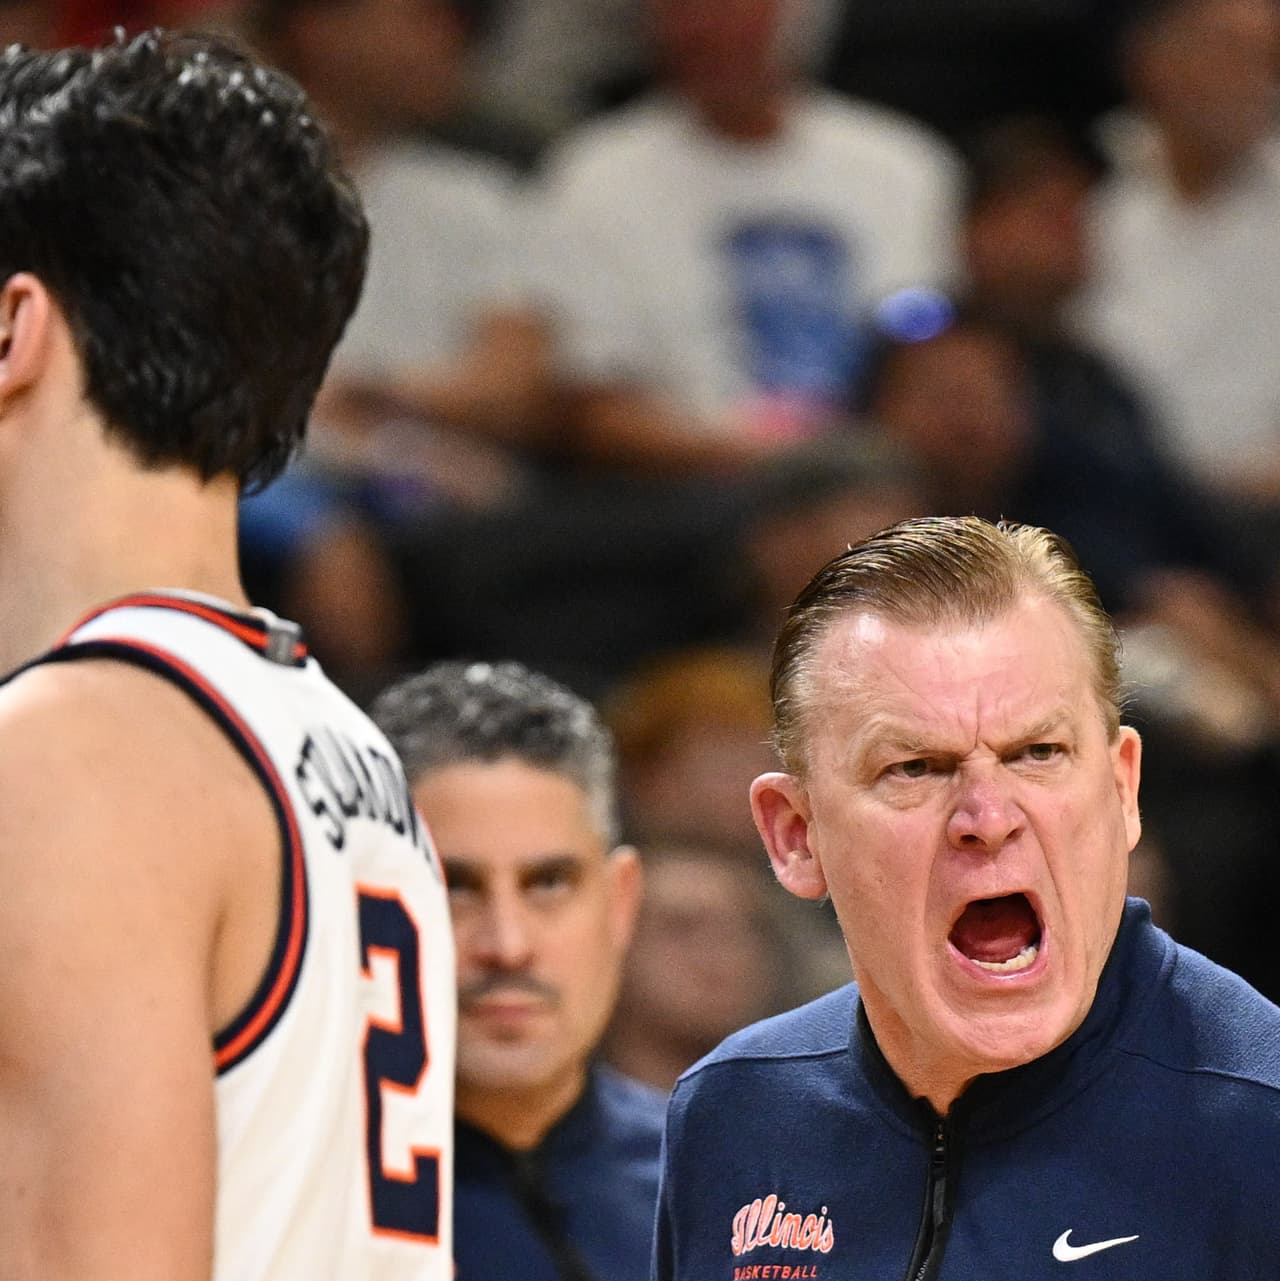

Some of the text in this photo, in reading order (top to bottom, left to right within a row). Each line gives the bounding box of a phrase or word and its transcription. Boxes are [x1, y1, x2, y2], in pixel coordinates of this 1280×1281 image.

[354, 882, 440, 1247] 2
[731, 1193, 835, 1256] Illinois
[733, 1265, 818, 1281] BASKETBALL
